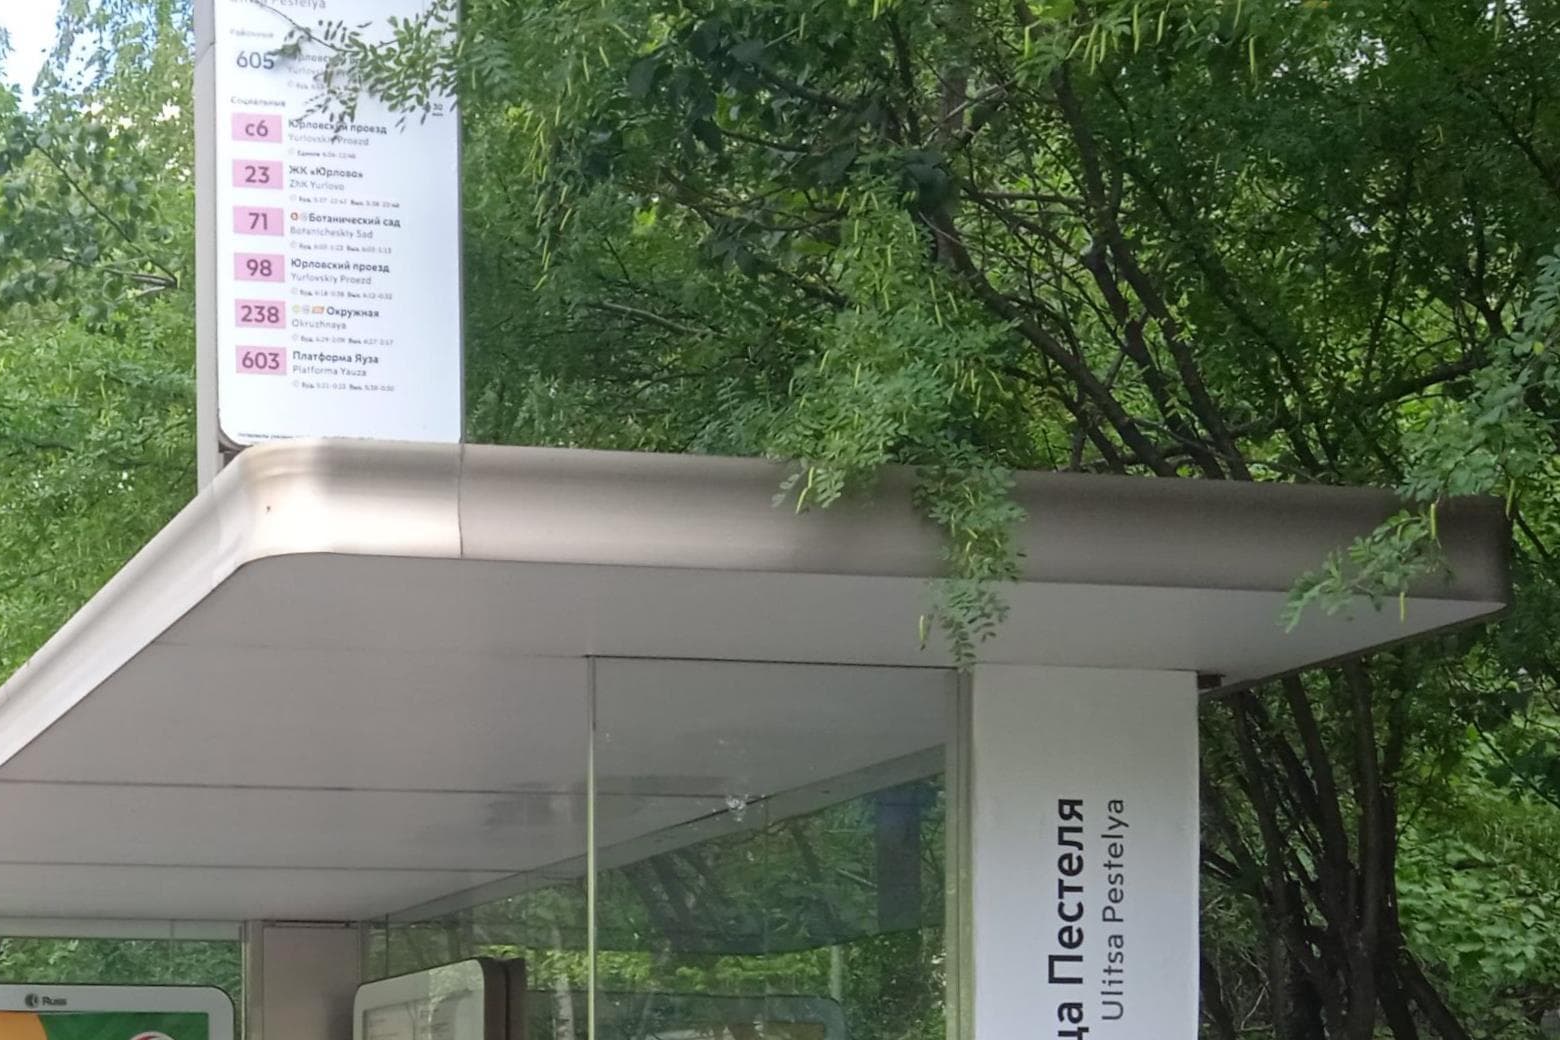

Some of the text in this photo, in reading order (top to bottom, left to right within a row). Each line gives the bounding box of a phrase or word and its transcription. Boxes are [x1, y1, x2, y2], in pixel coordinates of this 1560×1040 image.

[236, 51, 275, 69] 605
[351, 125, 388, 135] проезд
[245, 166, 270, 184] 23
[289, 165, 307, 175] ЖК
[248, 213, 401, 230] 71 Ботанический сад
[356, 230, 374, 239] Sad
[246, 259, 390, 277] 98 Юрловский проезд
[340, 275, 372, 285] Proezd
[240, 305, 380, 323] 238 Окружная
[242, 351, 379, 370] 603 Платформа Яуза
[340, 368, 367, 377] Yauza
[1048, 798, 1085, 985] Пестеля
[1101, 800, 1130, 1021] Ulitsa Pestelya
